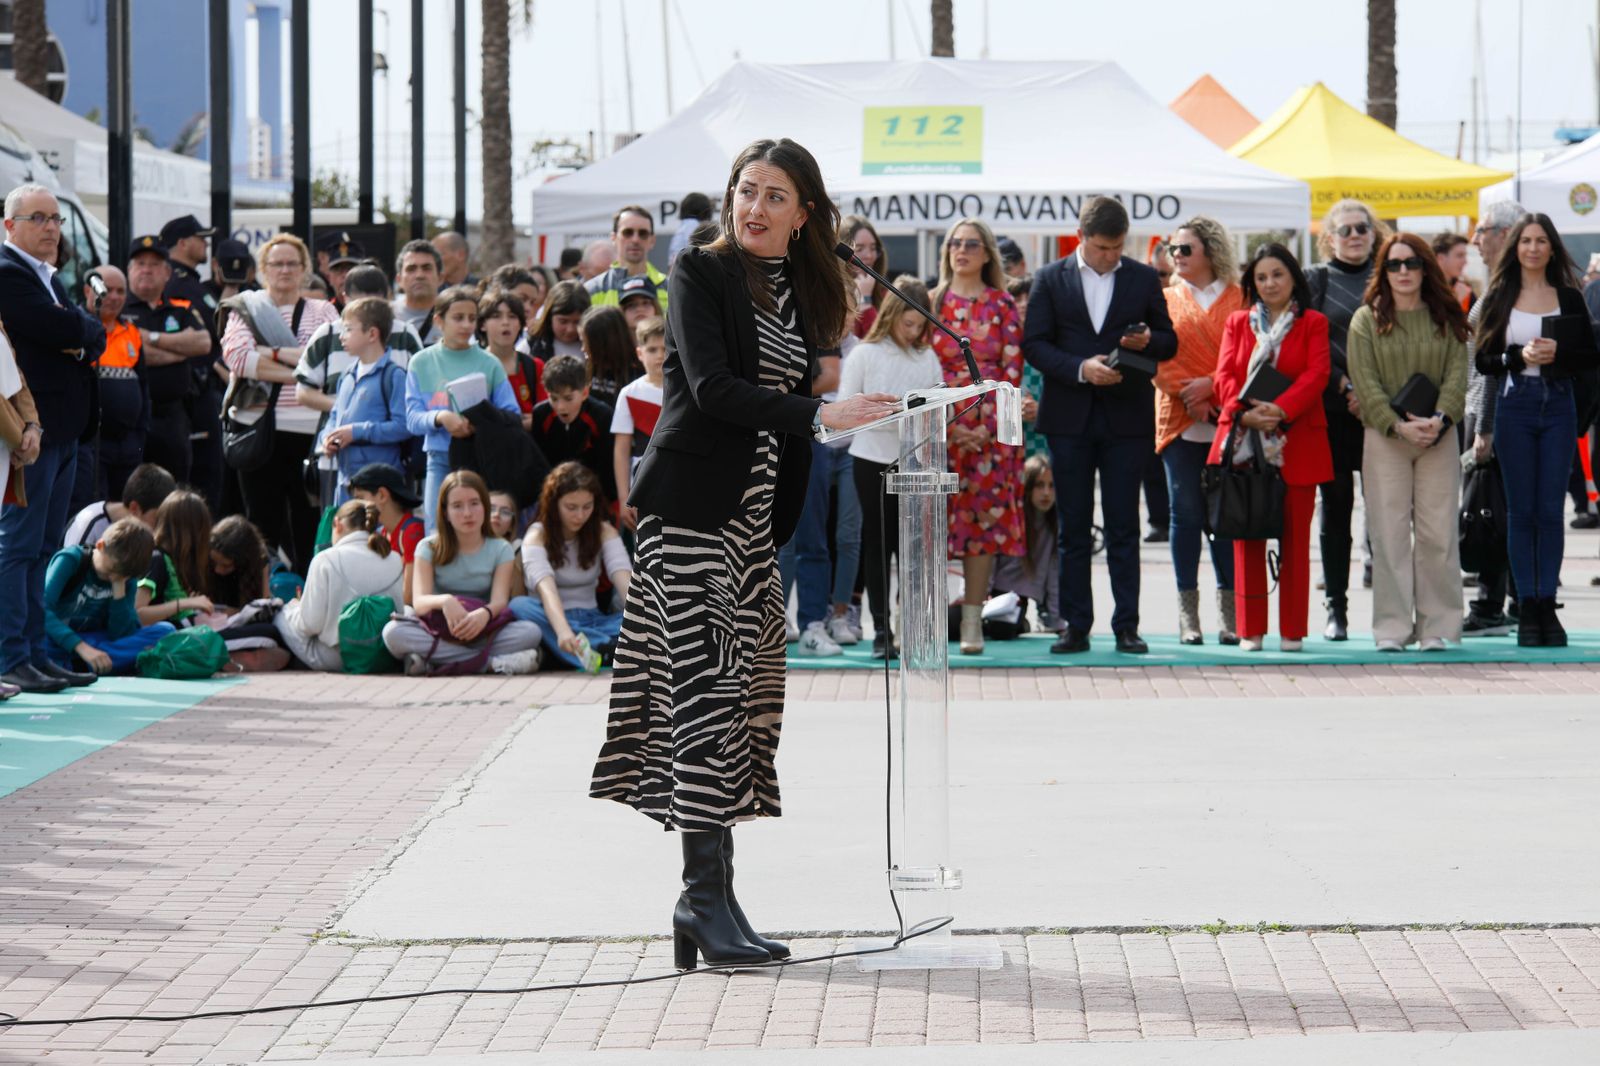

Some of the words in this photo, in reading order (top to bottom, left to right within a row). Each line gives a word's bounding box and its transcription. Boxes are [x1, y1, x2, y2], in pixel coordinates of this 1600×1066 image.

[882, 115, 964, 136] 112
[854, 193, 983, 220] MANDO
[994, 194, 1182, 220] AVANDO
[1397, 190, 1474, 203] AVANZADO
